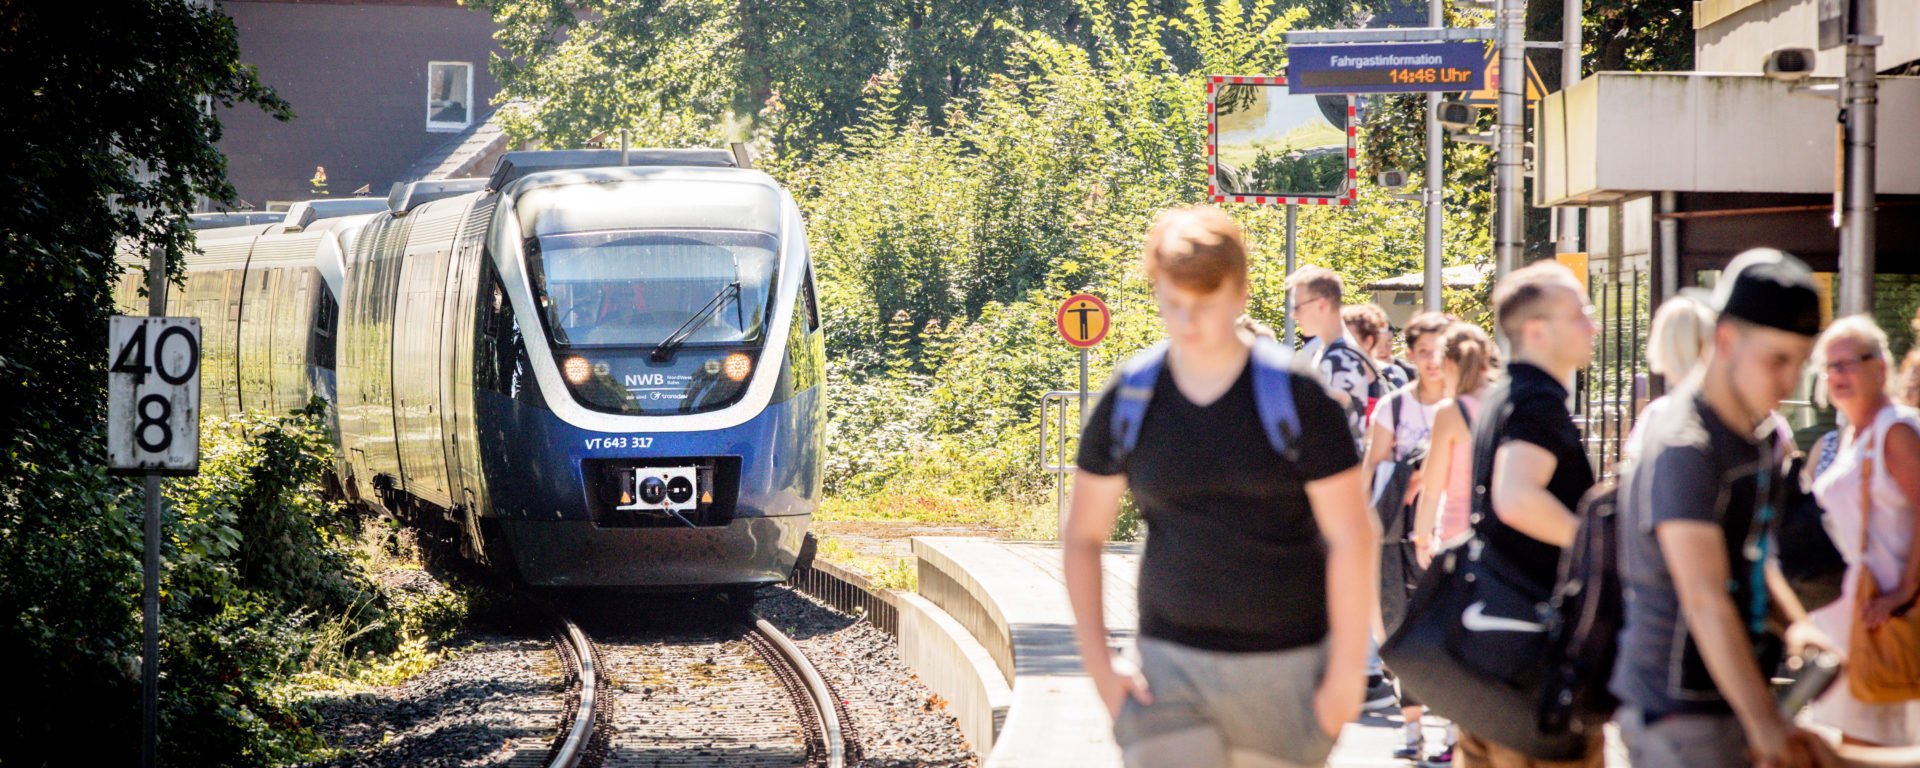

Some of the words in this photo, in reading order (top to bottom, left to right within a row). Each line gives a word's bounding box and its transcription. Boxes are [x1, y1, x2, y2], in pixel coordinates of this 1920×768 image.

[1330, 53, 1443, 69] Fahrgastinformation
[1389, 68, 1435, 84] 14:46
[1440, 67, 1472, 83] Uhr
[110, 323, 198, 386] 40
[625, 373, 664, 386] NWB
[136, 393, 173, 453] 8
[585, 438, 602, 450] VT
[603, 437, 627, 449] 643
[631, 437, 653, 448] 317
